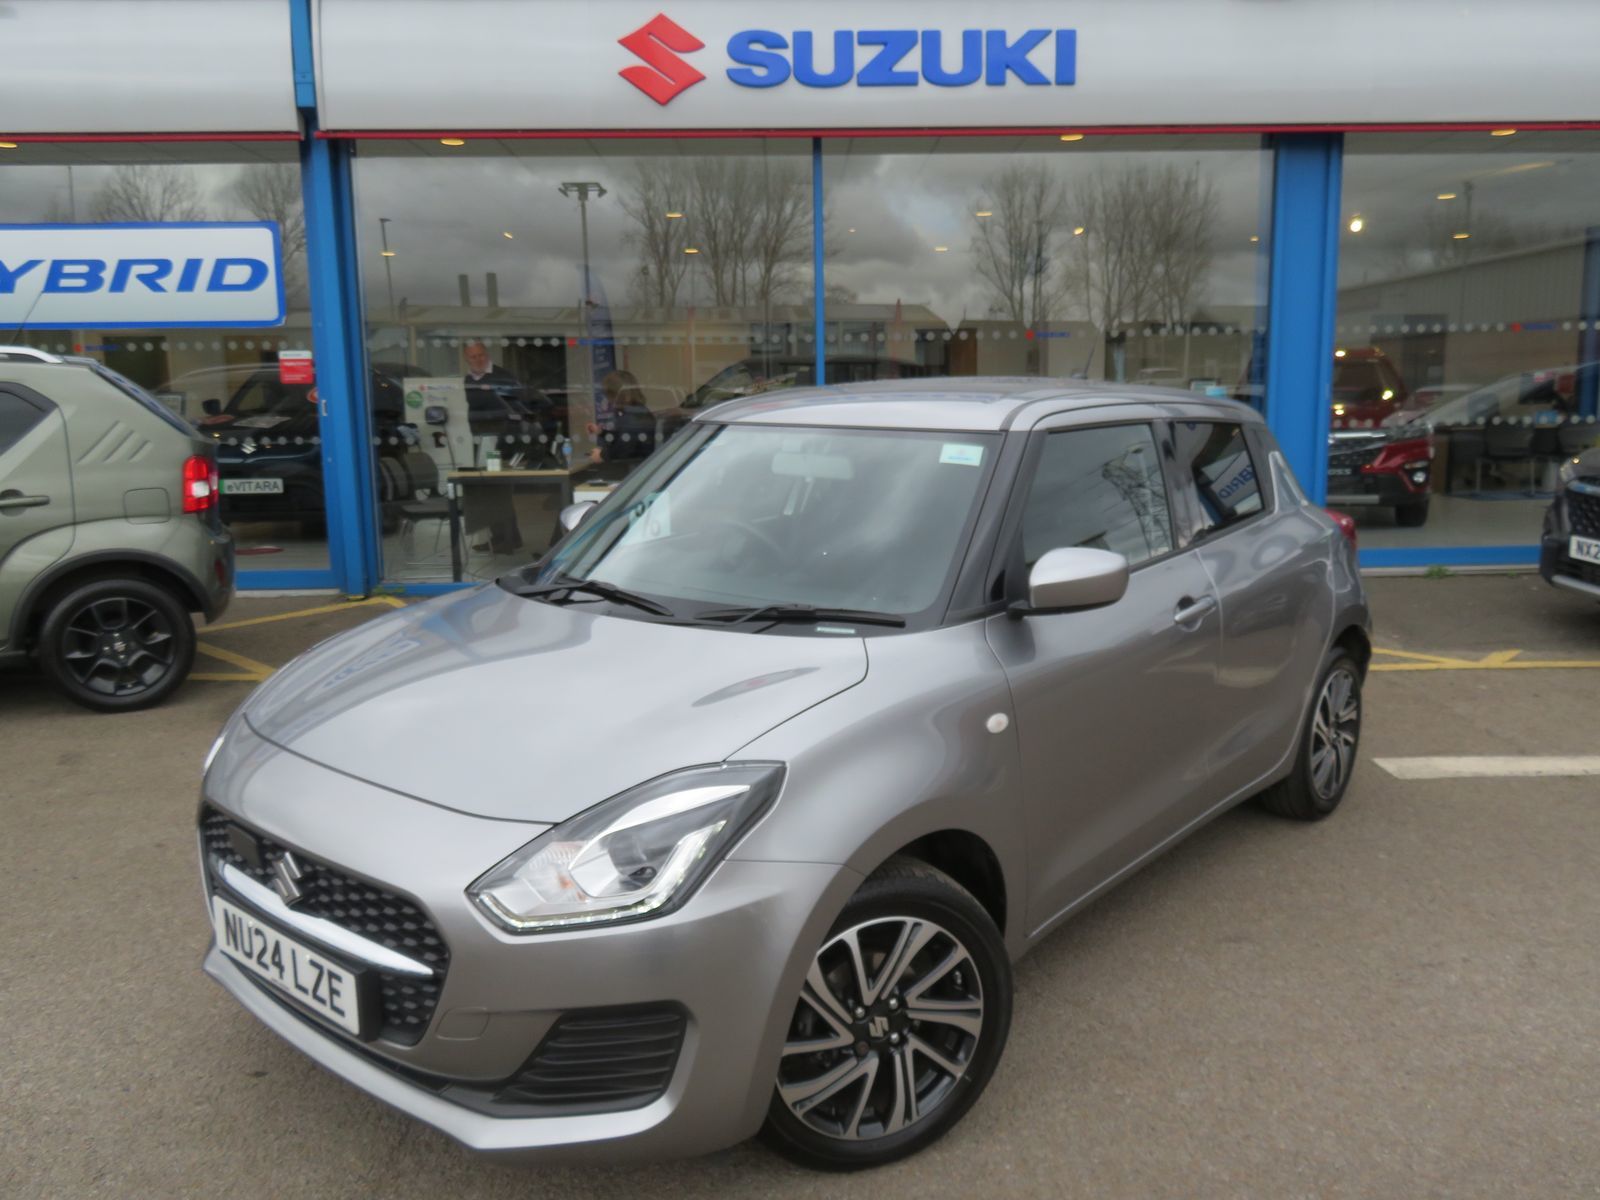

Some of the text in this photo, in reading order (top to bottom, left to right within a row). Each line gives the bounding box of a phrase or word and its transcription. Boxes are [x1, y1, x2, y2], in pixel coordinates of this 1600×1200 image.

[726, 29, 1077, 88] SUZUKI
[226, 480, 281, 492] eVITARA
[223, 908, 346, 1018] NU24 LZE
